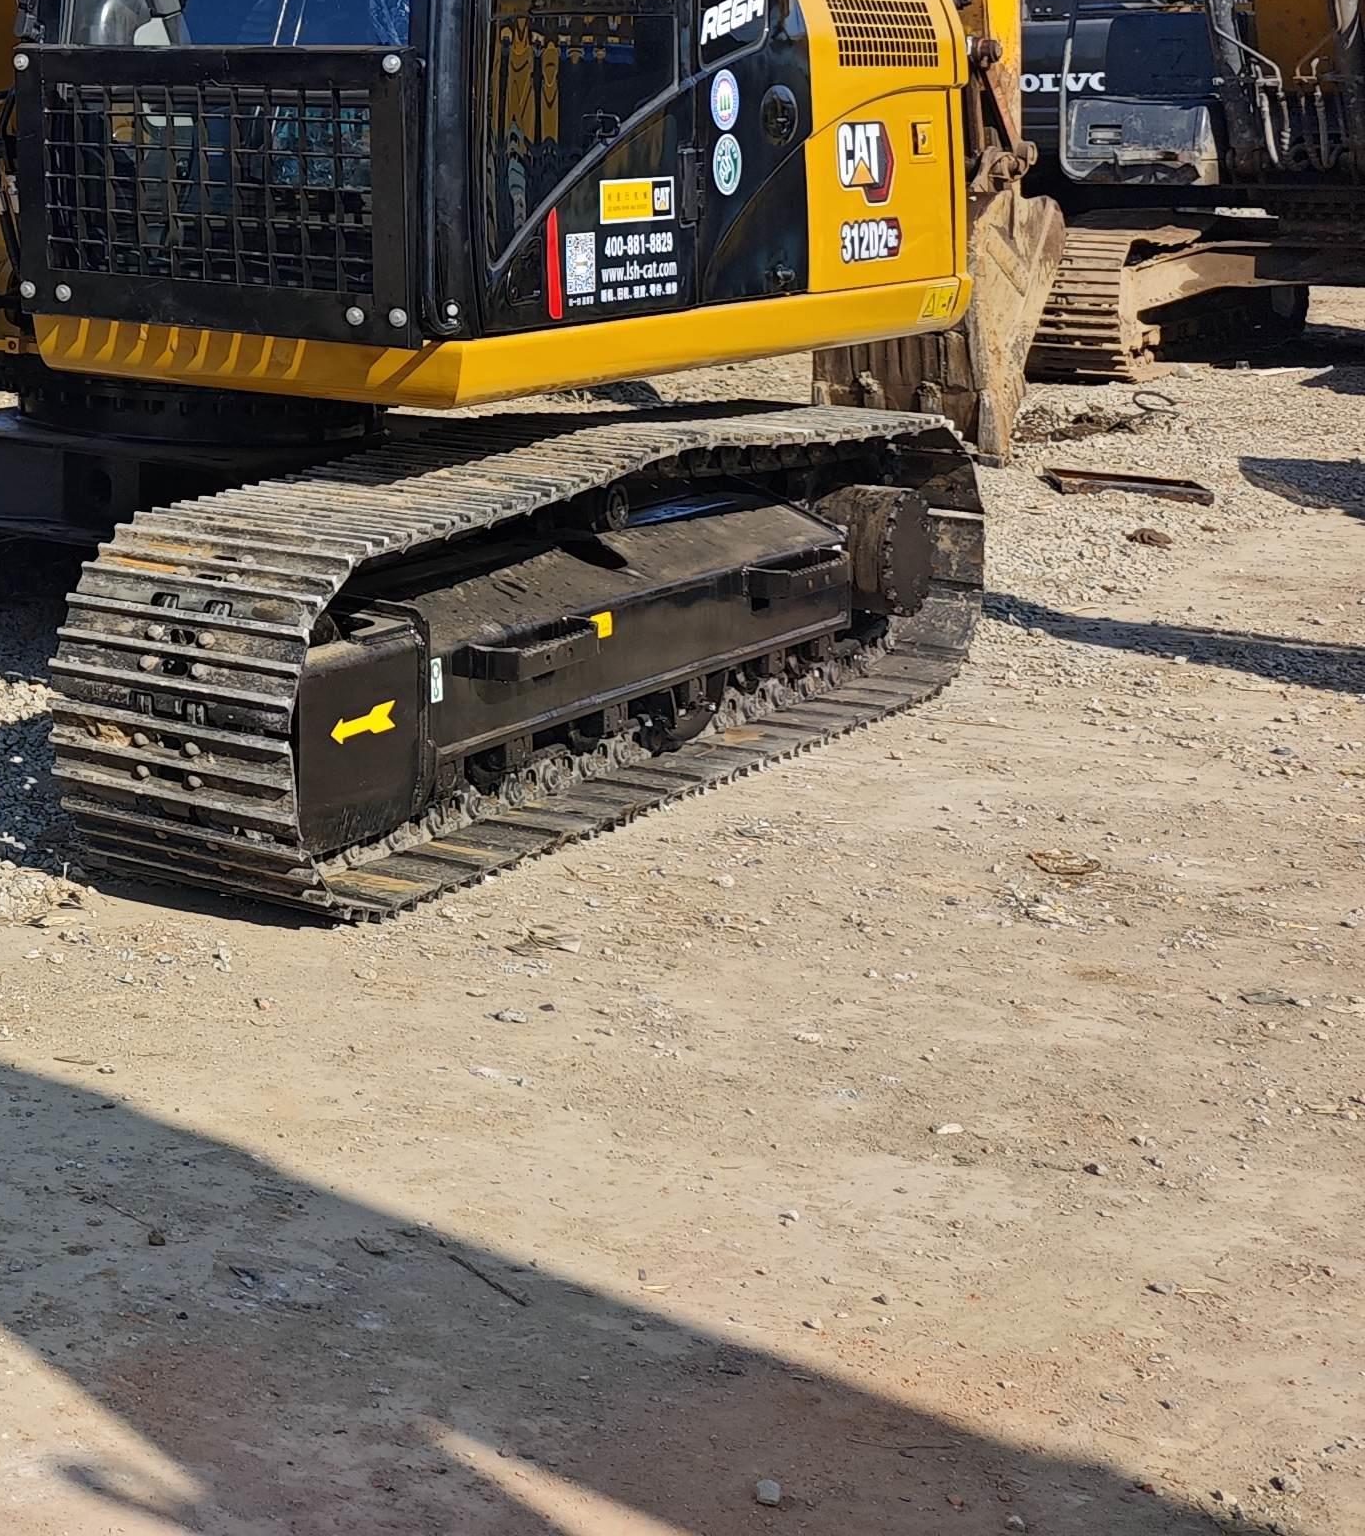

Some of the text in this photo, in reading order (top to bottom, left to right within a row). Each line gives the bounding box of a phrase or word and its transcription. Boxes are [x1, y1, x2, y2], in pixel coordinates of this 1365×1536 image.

[838, 123, 880, 186] CAT
[654, 187, 670, 210] CAT
[604, 232, 674, 258] 400-881-8829
[601, 260, 678, 283] www.lsh-cat.com
